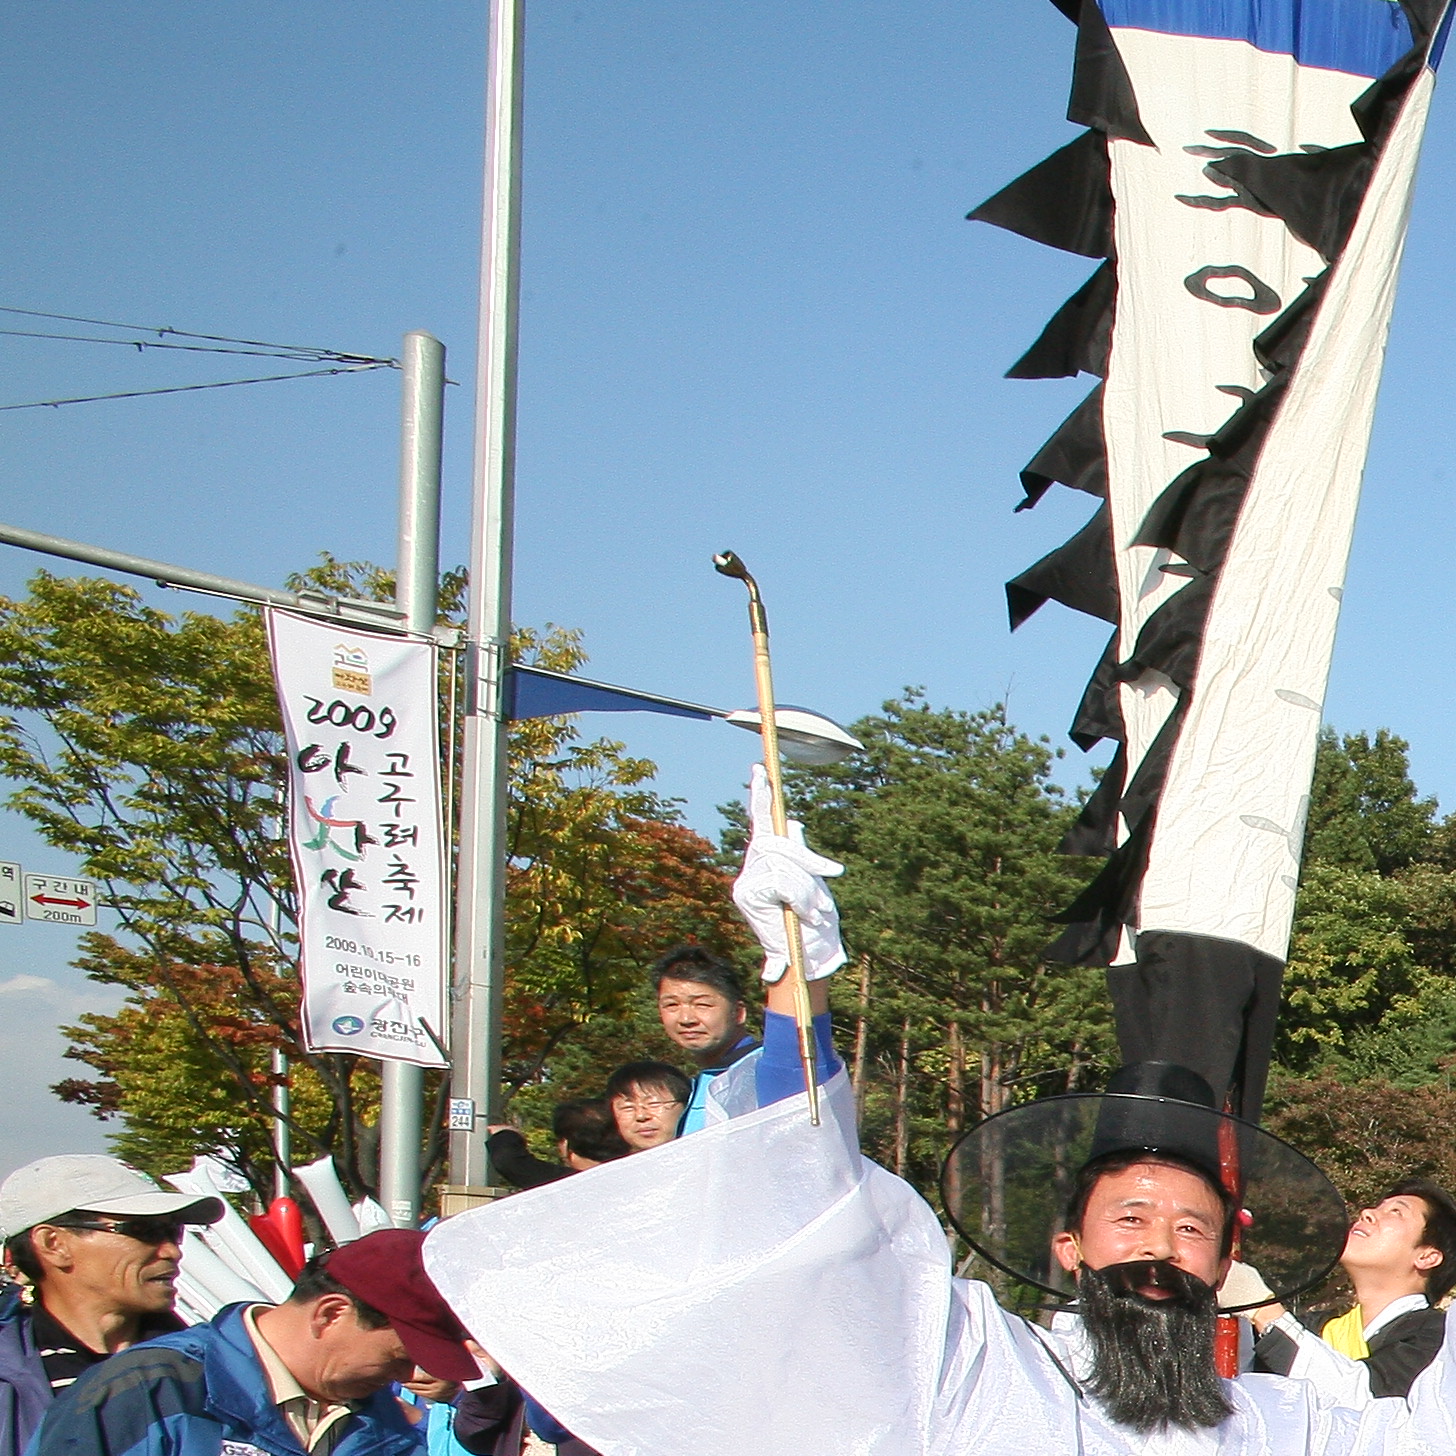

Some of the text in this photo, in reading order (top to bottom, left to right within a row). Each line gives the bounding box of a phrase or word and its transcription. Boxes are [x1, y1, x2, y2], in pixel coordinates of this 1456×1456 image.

[302, 694, 397, 739] 2009
[43, 909, 82, 923] 200m
[325, 935, 422, 968] 2009.10.15-16
[371, 1018, 425, 1039] 광진구
[452, 1115, 469, 1127] 244
